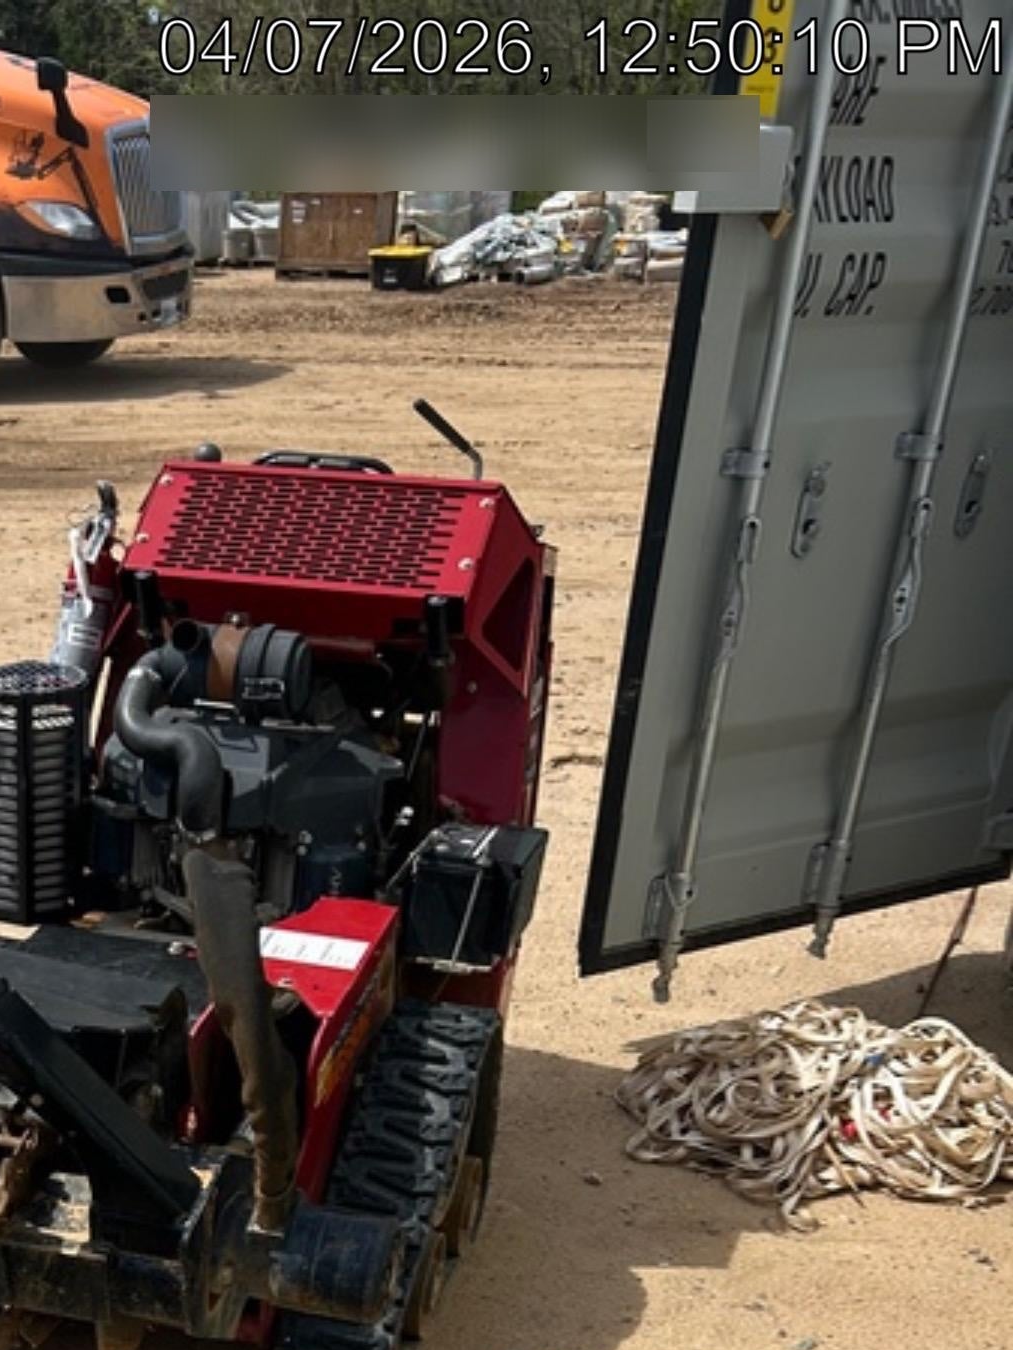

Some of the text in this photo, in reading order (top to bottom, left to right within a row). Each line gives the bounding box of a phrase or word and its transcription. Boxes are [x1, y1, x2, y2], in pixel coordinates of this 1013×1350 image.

[828, 55, 887, 127] ARE
[792, 155, 894, 223] YLOAD
[823, 252, 886, 317] CAP.
